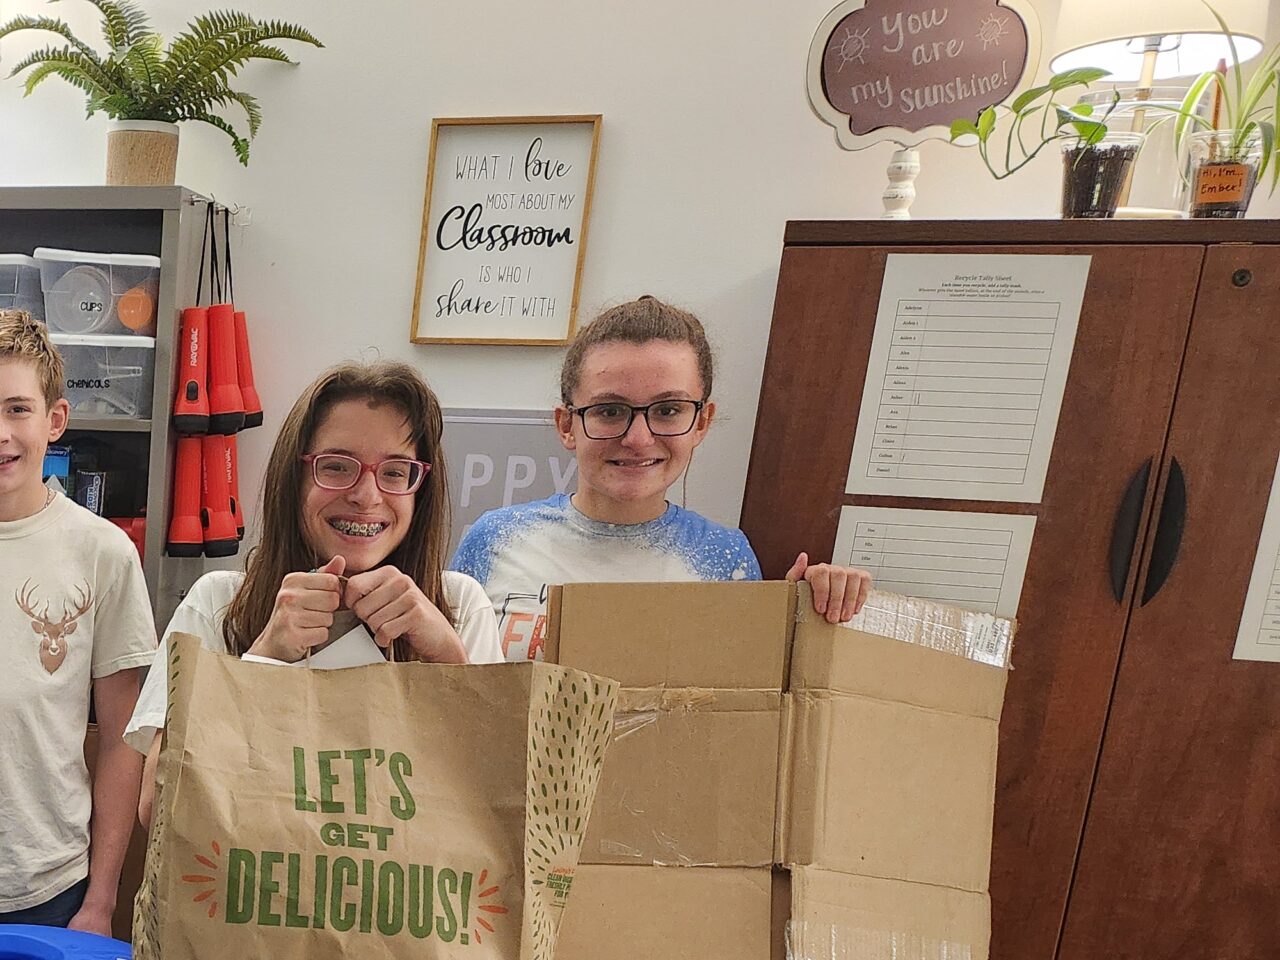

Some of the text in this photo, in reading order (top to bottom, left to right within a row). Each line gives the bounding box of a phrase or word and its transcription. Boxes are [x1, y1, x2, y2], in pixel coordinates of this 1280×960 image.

[882, 8, 948, 52] You
[911, 39, 964, 66] are
[851, 60, 1009, 113] my sunshine!
[455, 136, 572, 183] WHAT I love
[486, 193, 576, 211] MOST ABOUT MY
[1200, 178, 1243, 195] Ember!
[436, 203, 574, 251] Classroom
[479, 265, 531, 283] IS WHO I
[435, 278, 556, 319] share IT WITH
[190, 327, 199, 367] RAYOVAC
[86, 487, 94, 507] KIDS
[293, 745, 417, 821] LET'S
[320, 822, 394, 851] GET
[225, 847, 473, 945] DELICIOUS!
